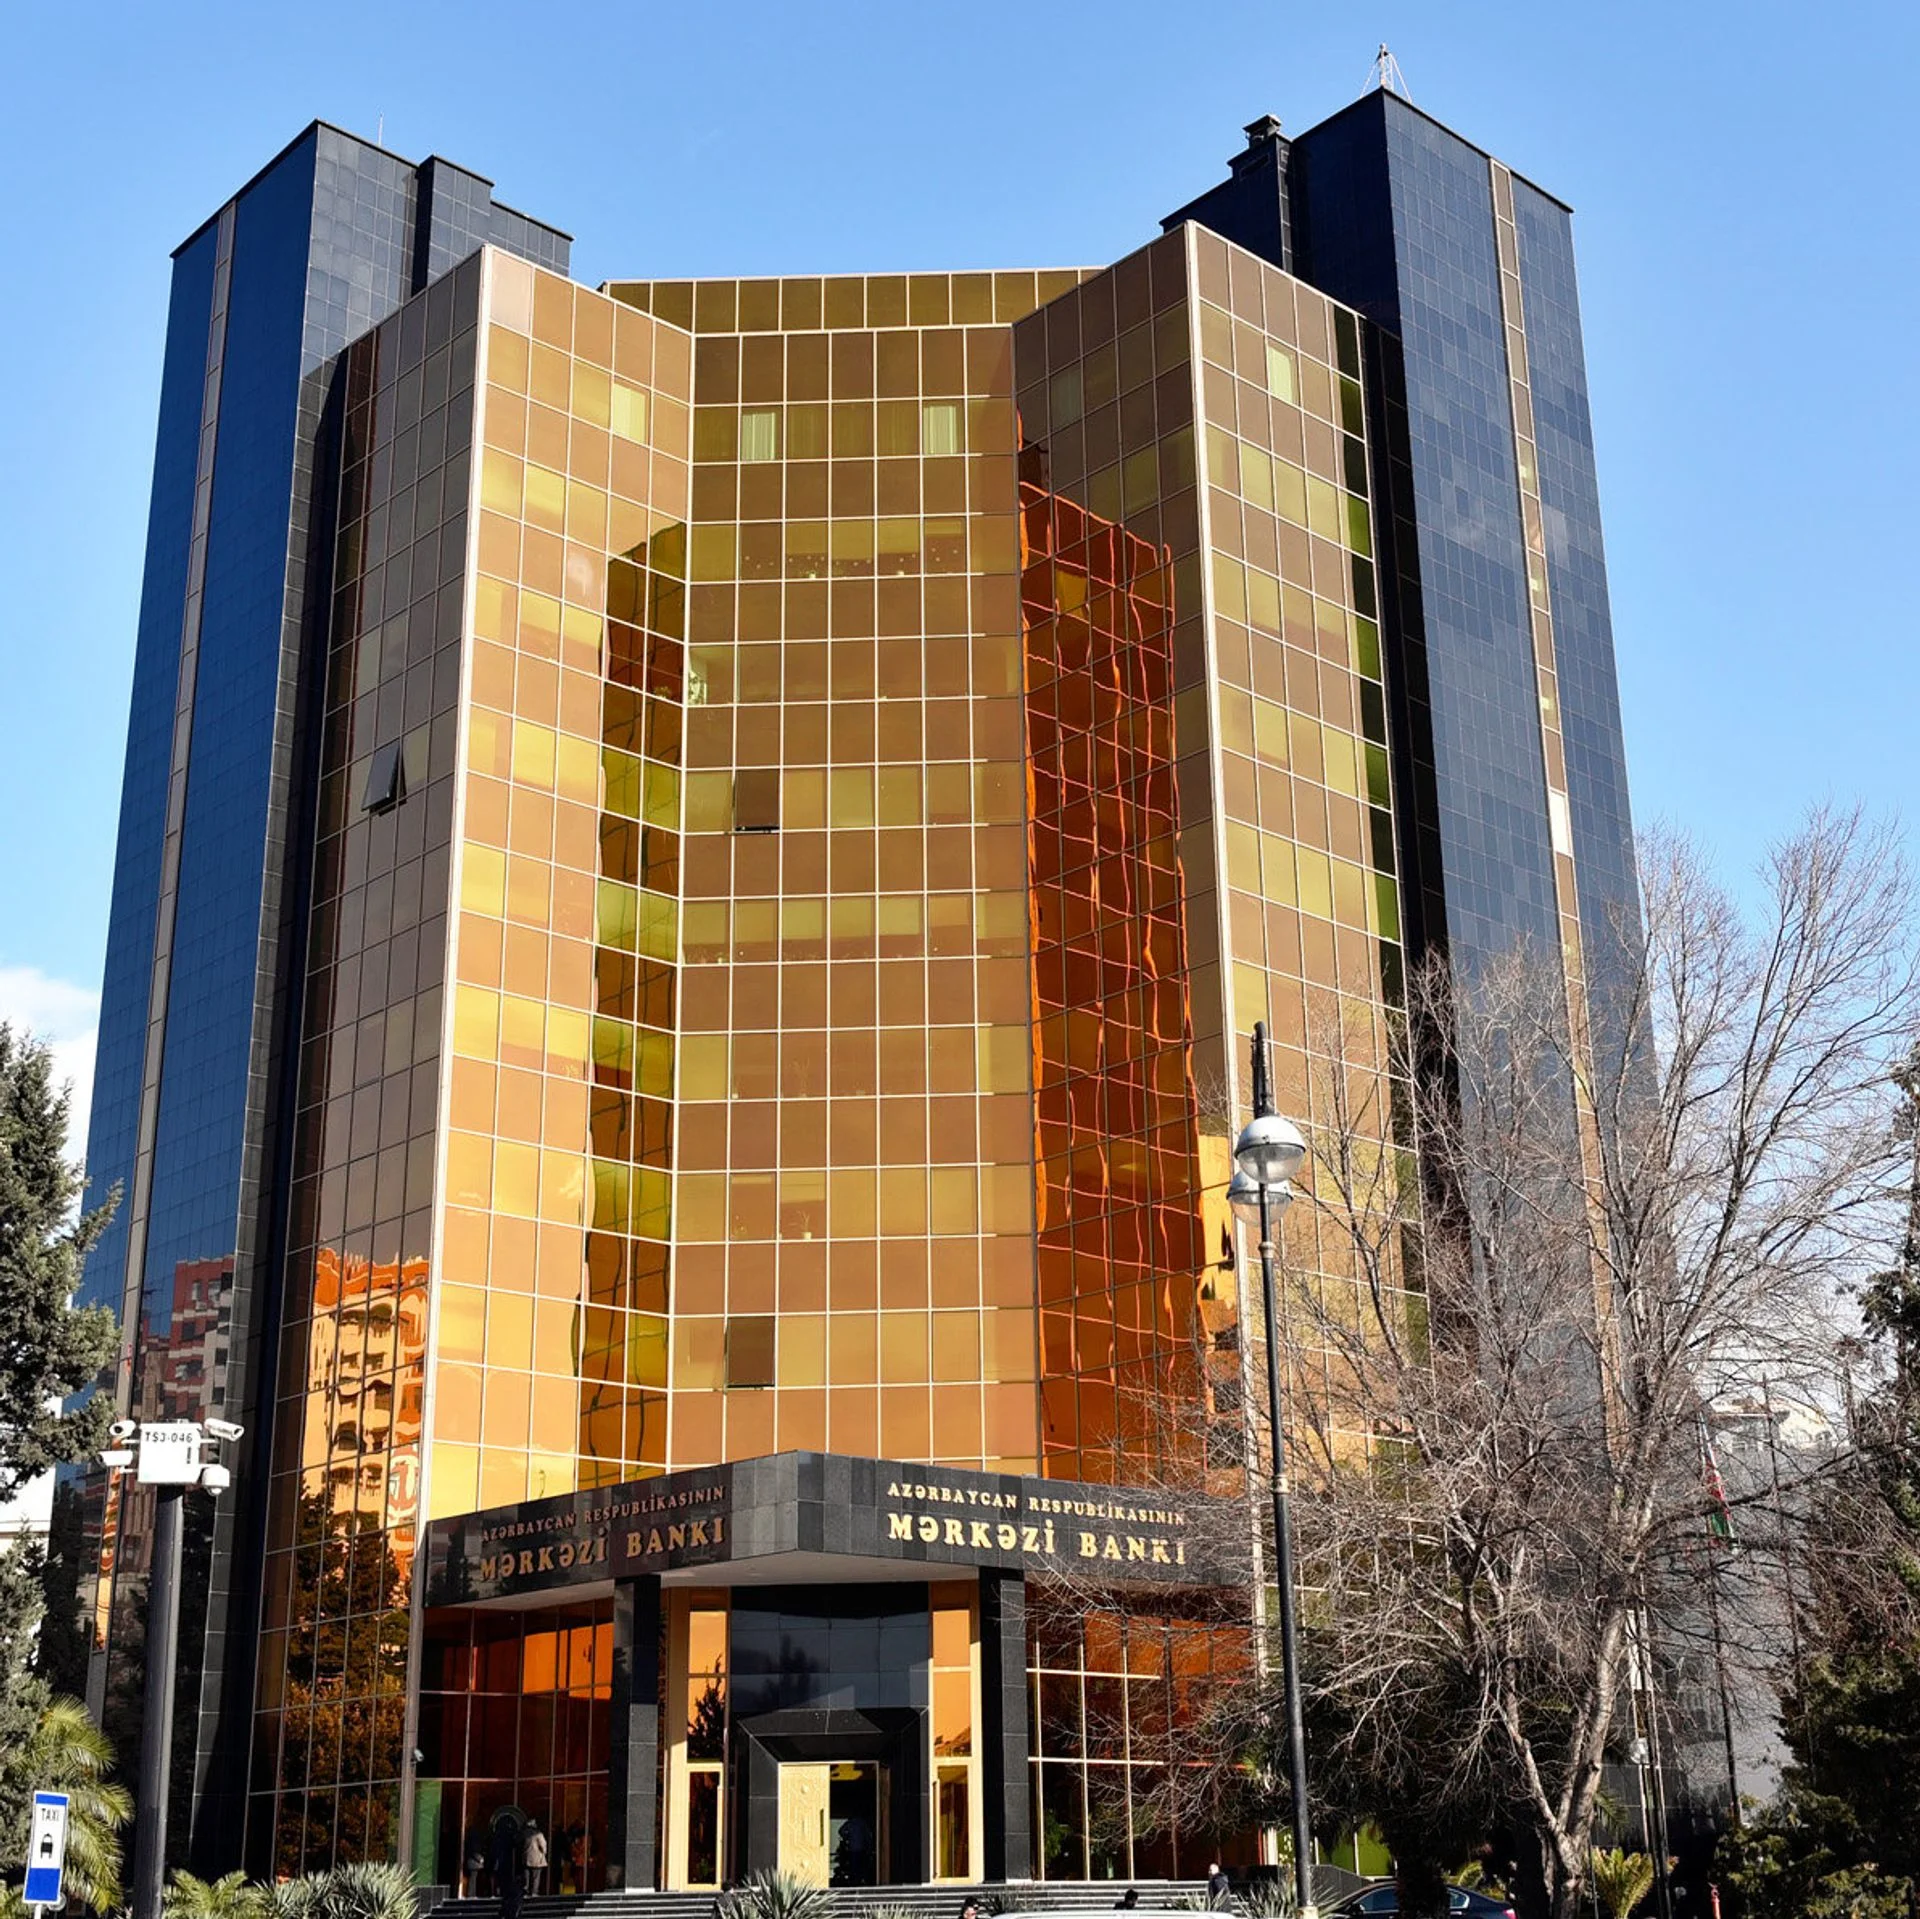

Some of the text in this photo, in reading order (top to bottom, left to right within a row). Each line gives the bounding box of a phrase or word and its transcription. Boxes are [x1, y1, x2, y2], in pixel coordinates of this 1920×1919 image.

[482, 1486, 724, 1542] AZƏRBAYCAN RESPUBLİKASININ
[888, 1482, 1185, 1525] AZƏRBAYCAN RESPUBLİKASININ
[481, 1516, 724, 1580] MƏRKƏZİ BANKI
[888, 1513, 1186, 1565] MƏRKƏZİ BANKI
[41, 1808, 59, 1821] TAXI
